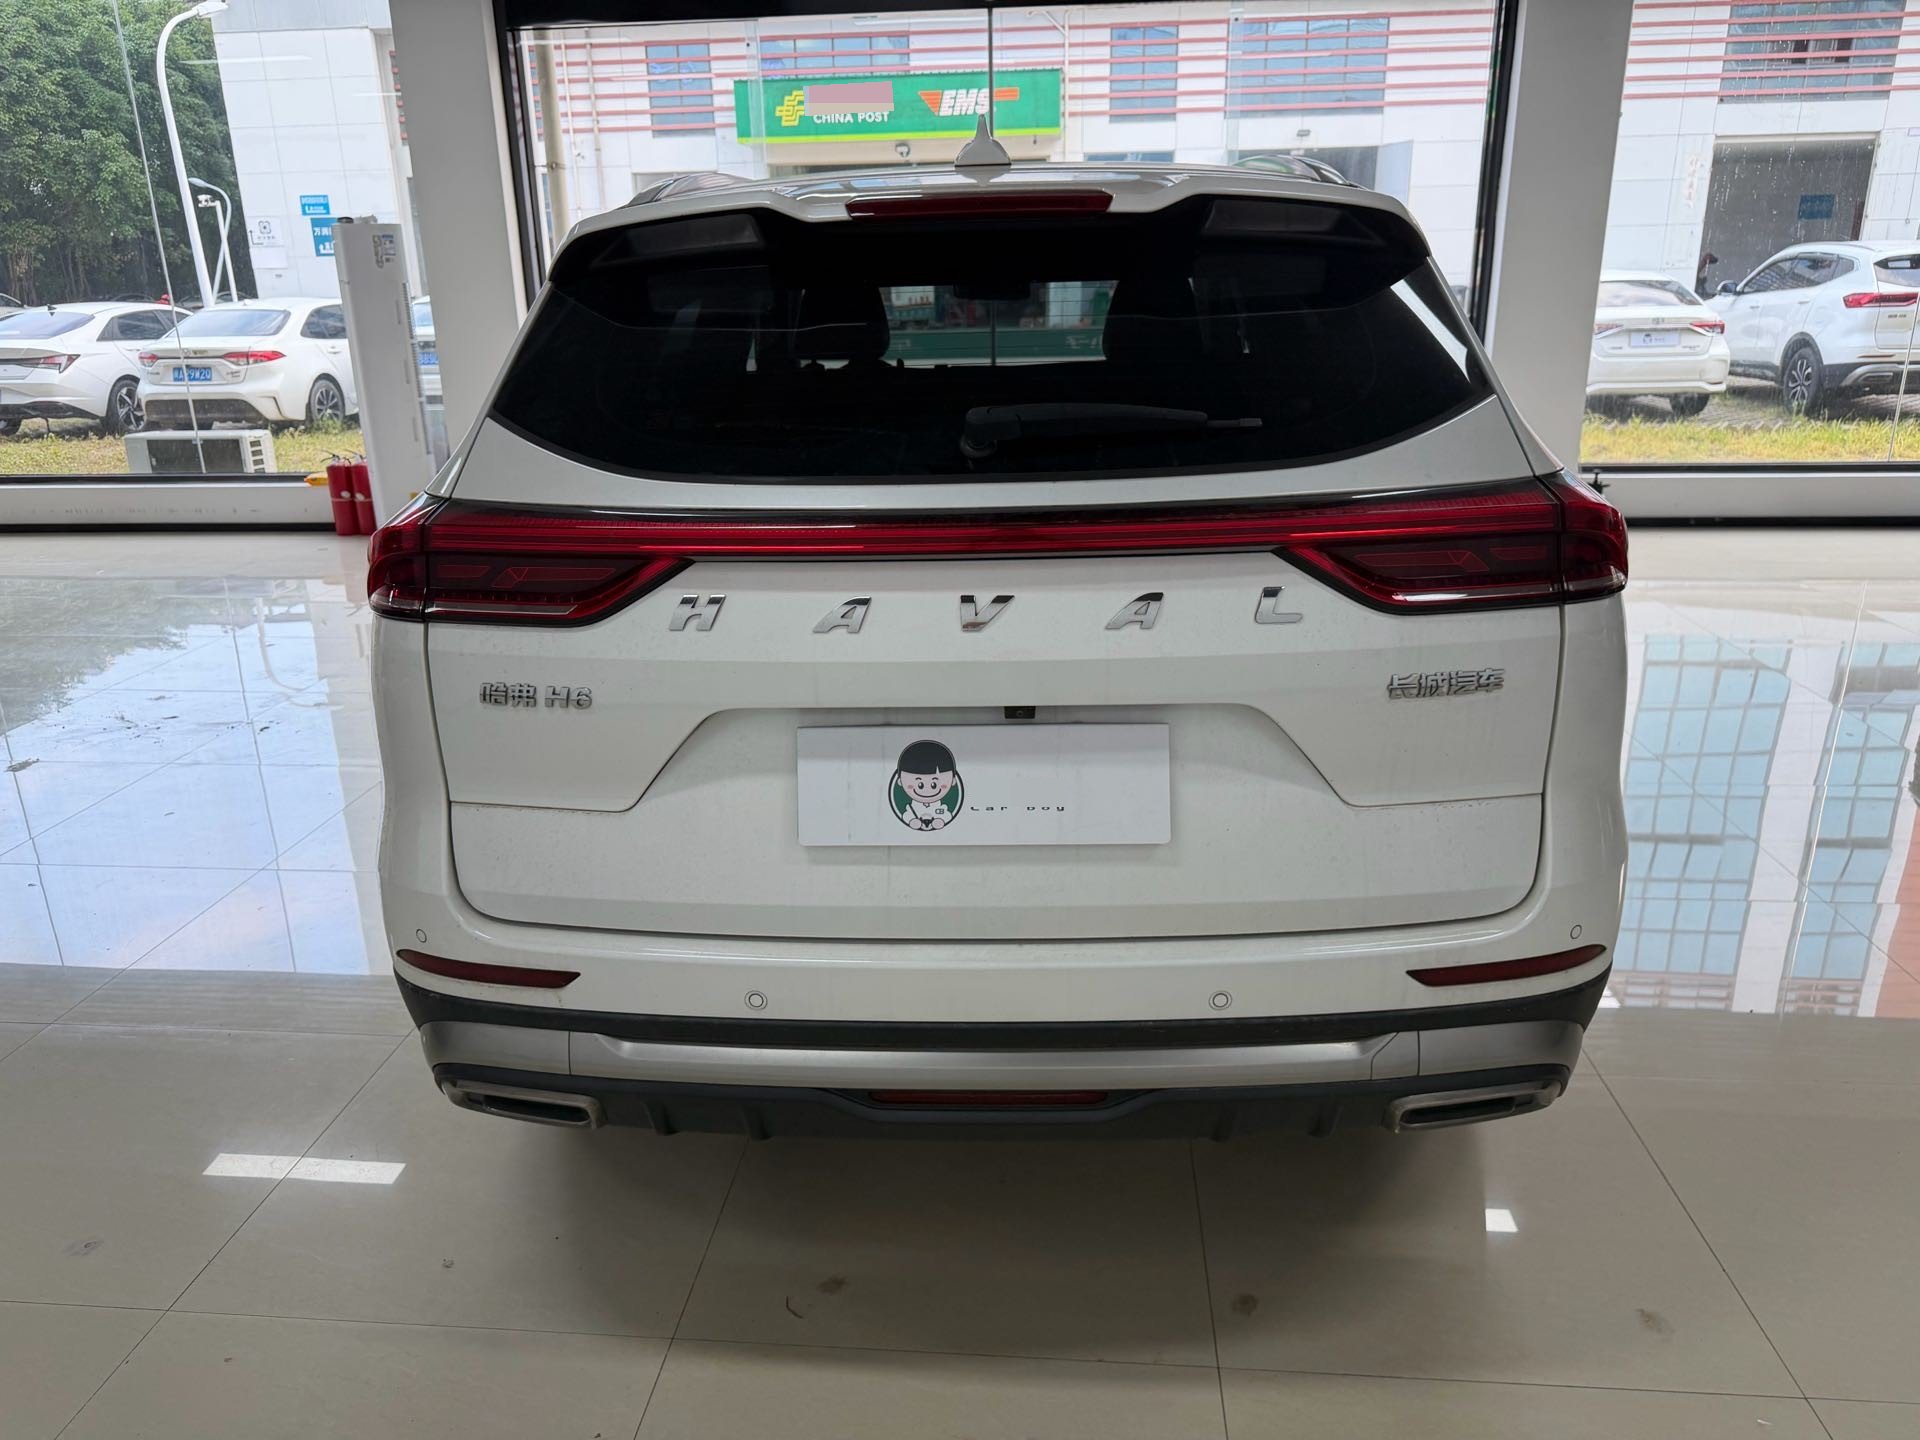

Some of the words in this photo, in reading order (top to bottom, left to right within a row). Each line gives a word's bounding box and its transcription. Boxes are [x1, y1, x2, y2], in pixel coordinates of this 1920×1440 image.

[940, 88, 995, 116] EMS
[813, 112, 853, 124] CHINA
[858, 110, 889, 123] POST
[669, 586, 1304, 634] HAVAL
[480, 682, 537, 708] 哈弗
[544, 686, 592, 709] H6
[1387, 667, 1505, 699] 长城汽车
